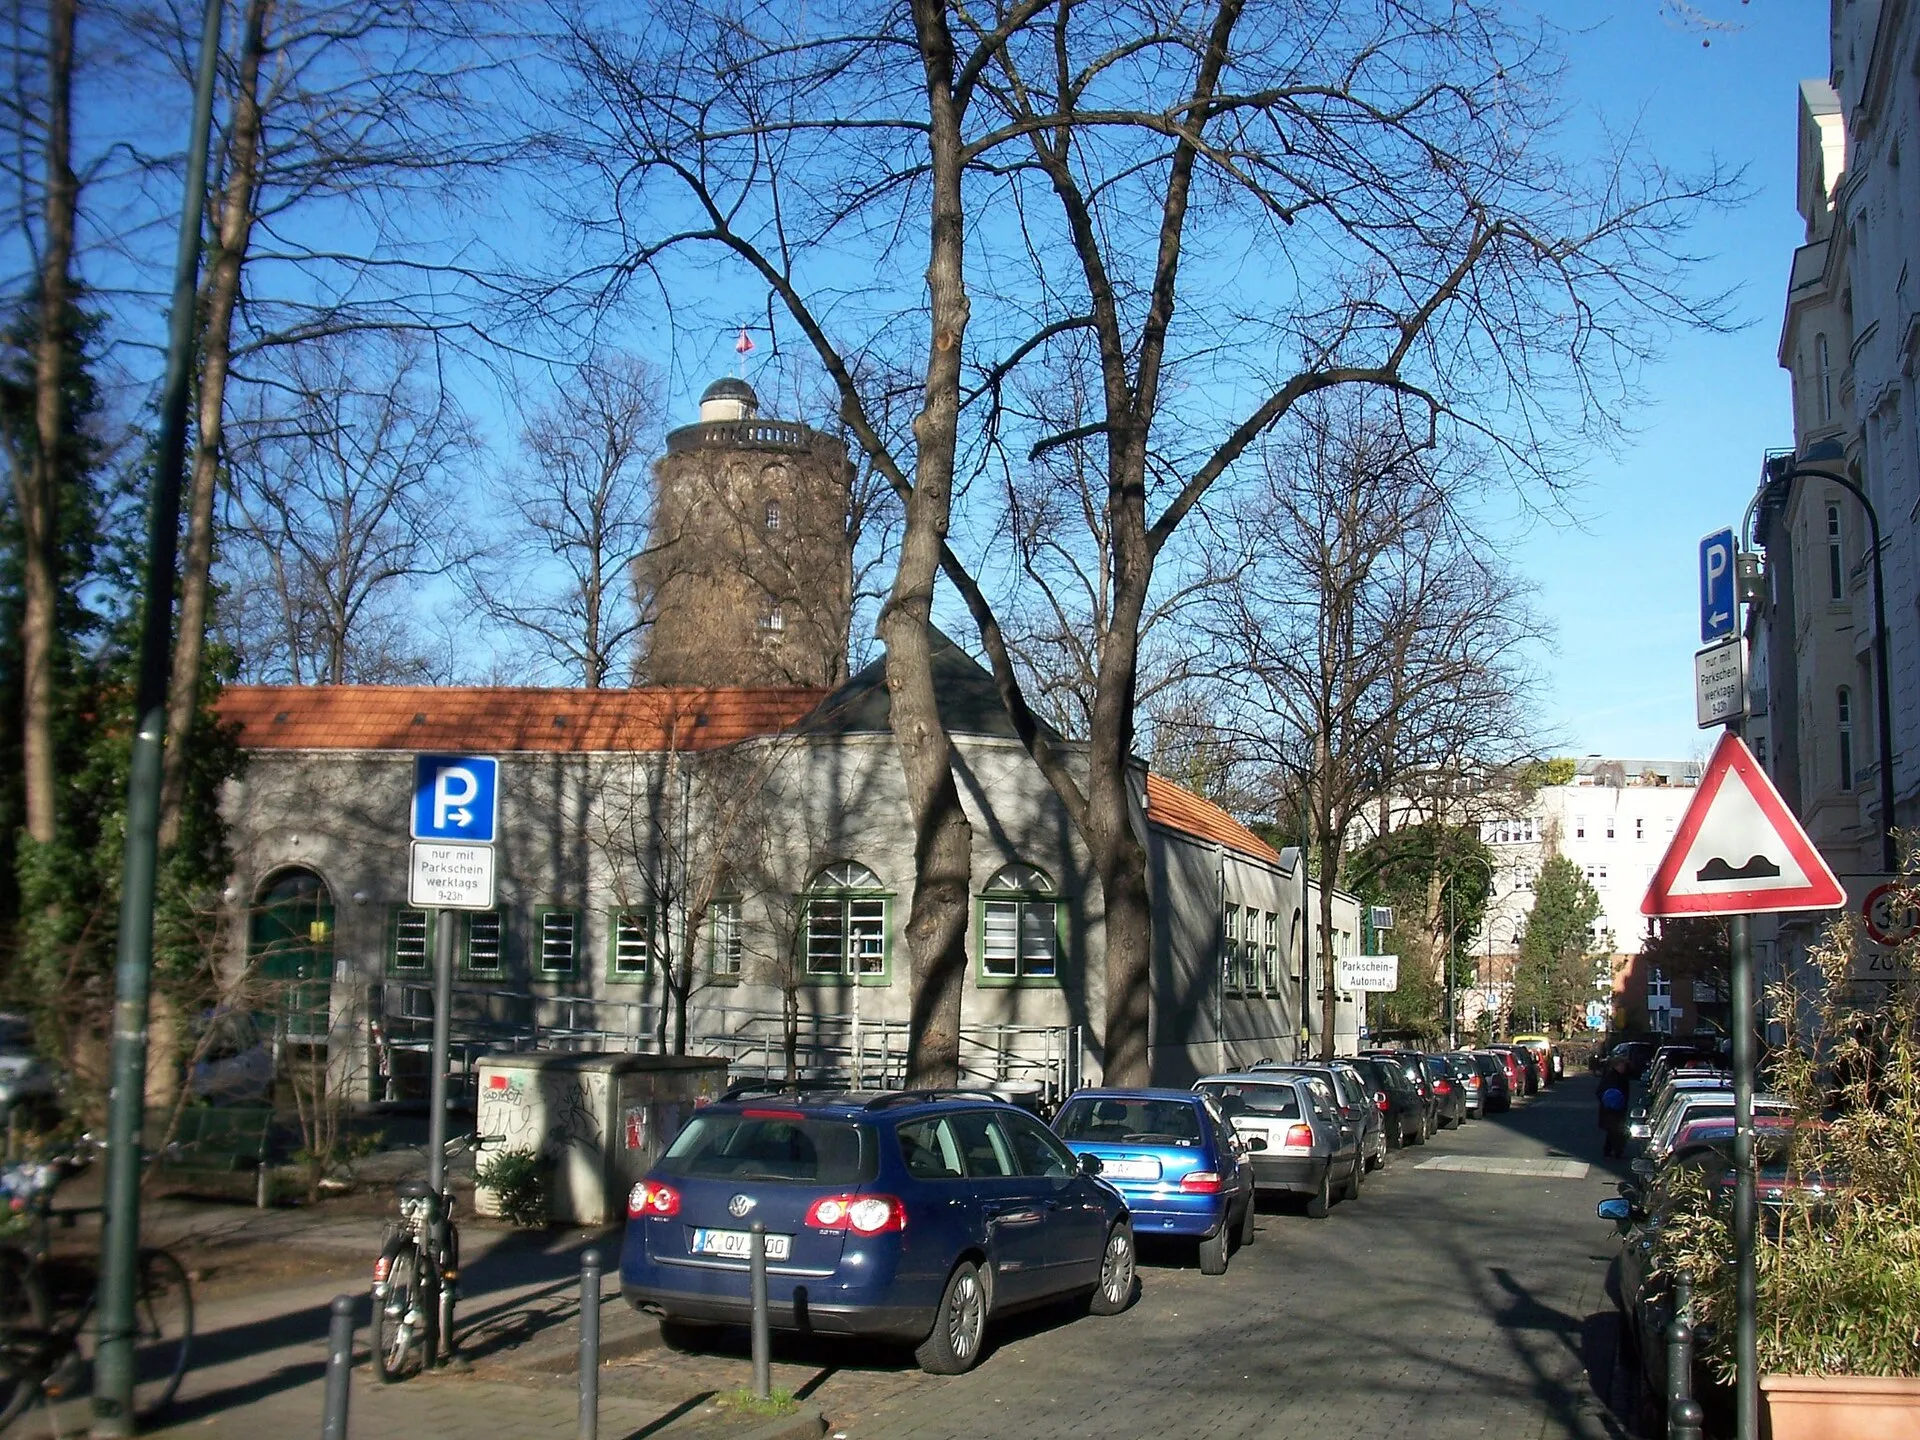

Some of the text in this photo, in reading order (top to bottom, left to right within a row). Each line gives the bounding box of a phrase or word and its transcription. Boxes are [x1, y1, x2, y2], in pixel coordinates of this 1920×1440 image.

[1707, 543, 1727, 605] P
[1701, 666, 1738, 686] Parkschein
[1704, 684, 1735, 701] werktags
[433, 766, 477, 829] P
[432, 850, 474, 860] nur mit
[421, 861, 484, 876] Parkschein
[426, 877, 479, 889] werktags
[438, 890, 463, 901] 9-23h
[1342, 961, 1394, 972] Parkschein-
[1350, 976, 1386, 986] Automat
[1360, 1027, 1368, 1038] P
[705, 1233, 716, 1249] K
[725, 1235, 745, 1251] QV
